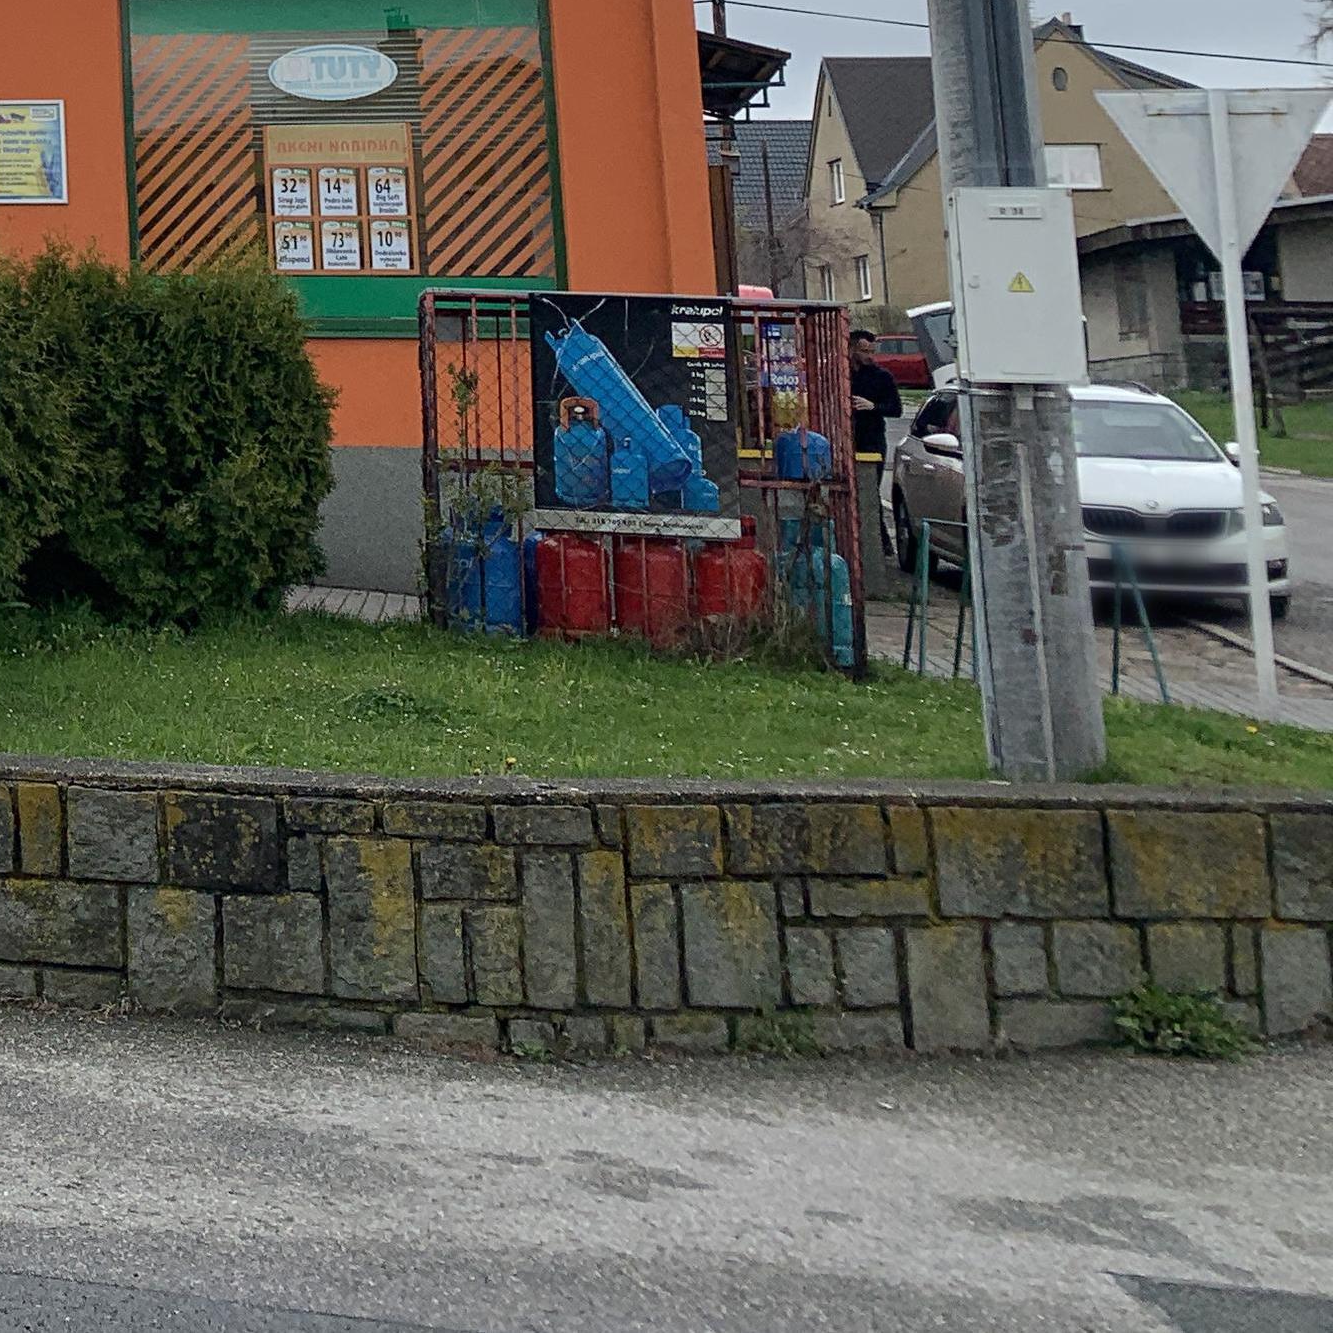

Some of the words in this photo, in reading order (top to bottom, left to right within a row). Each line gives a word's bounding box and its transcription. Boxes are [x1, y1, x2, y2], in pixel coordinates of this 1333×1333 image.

[311, 54, 381, 80] TUTY
[280, 178, 298, 193] 32
[324, 178, 342, 193] 14
[375, 178, 391, 194] 64
[283, 235, 298, 250] 51
[331, 232, 345, 247] 73
[377, 231, 393, 247] 10
[671, 304, 724, 317] kralupol
